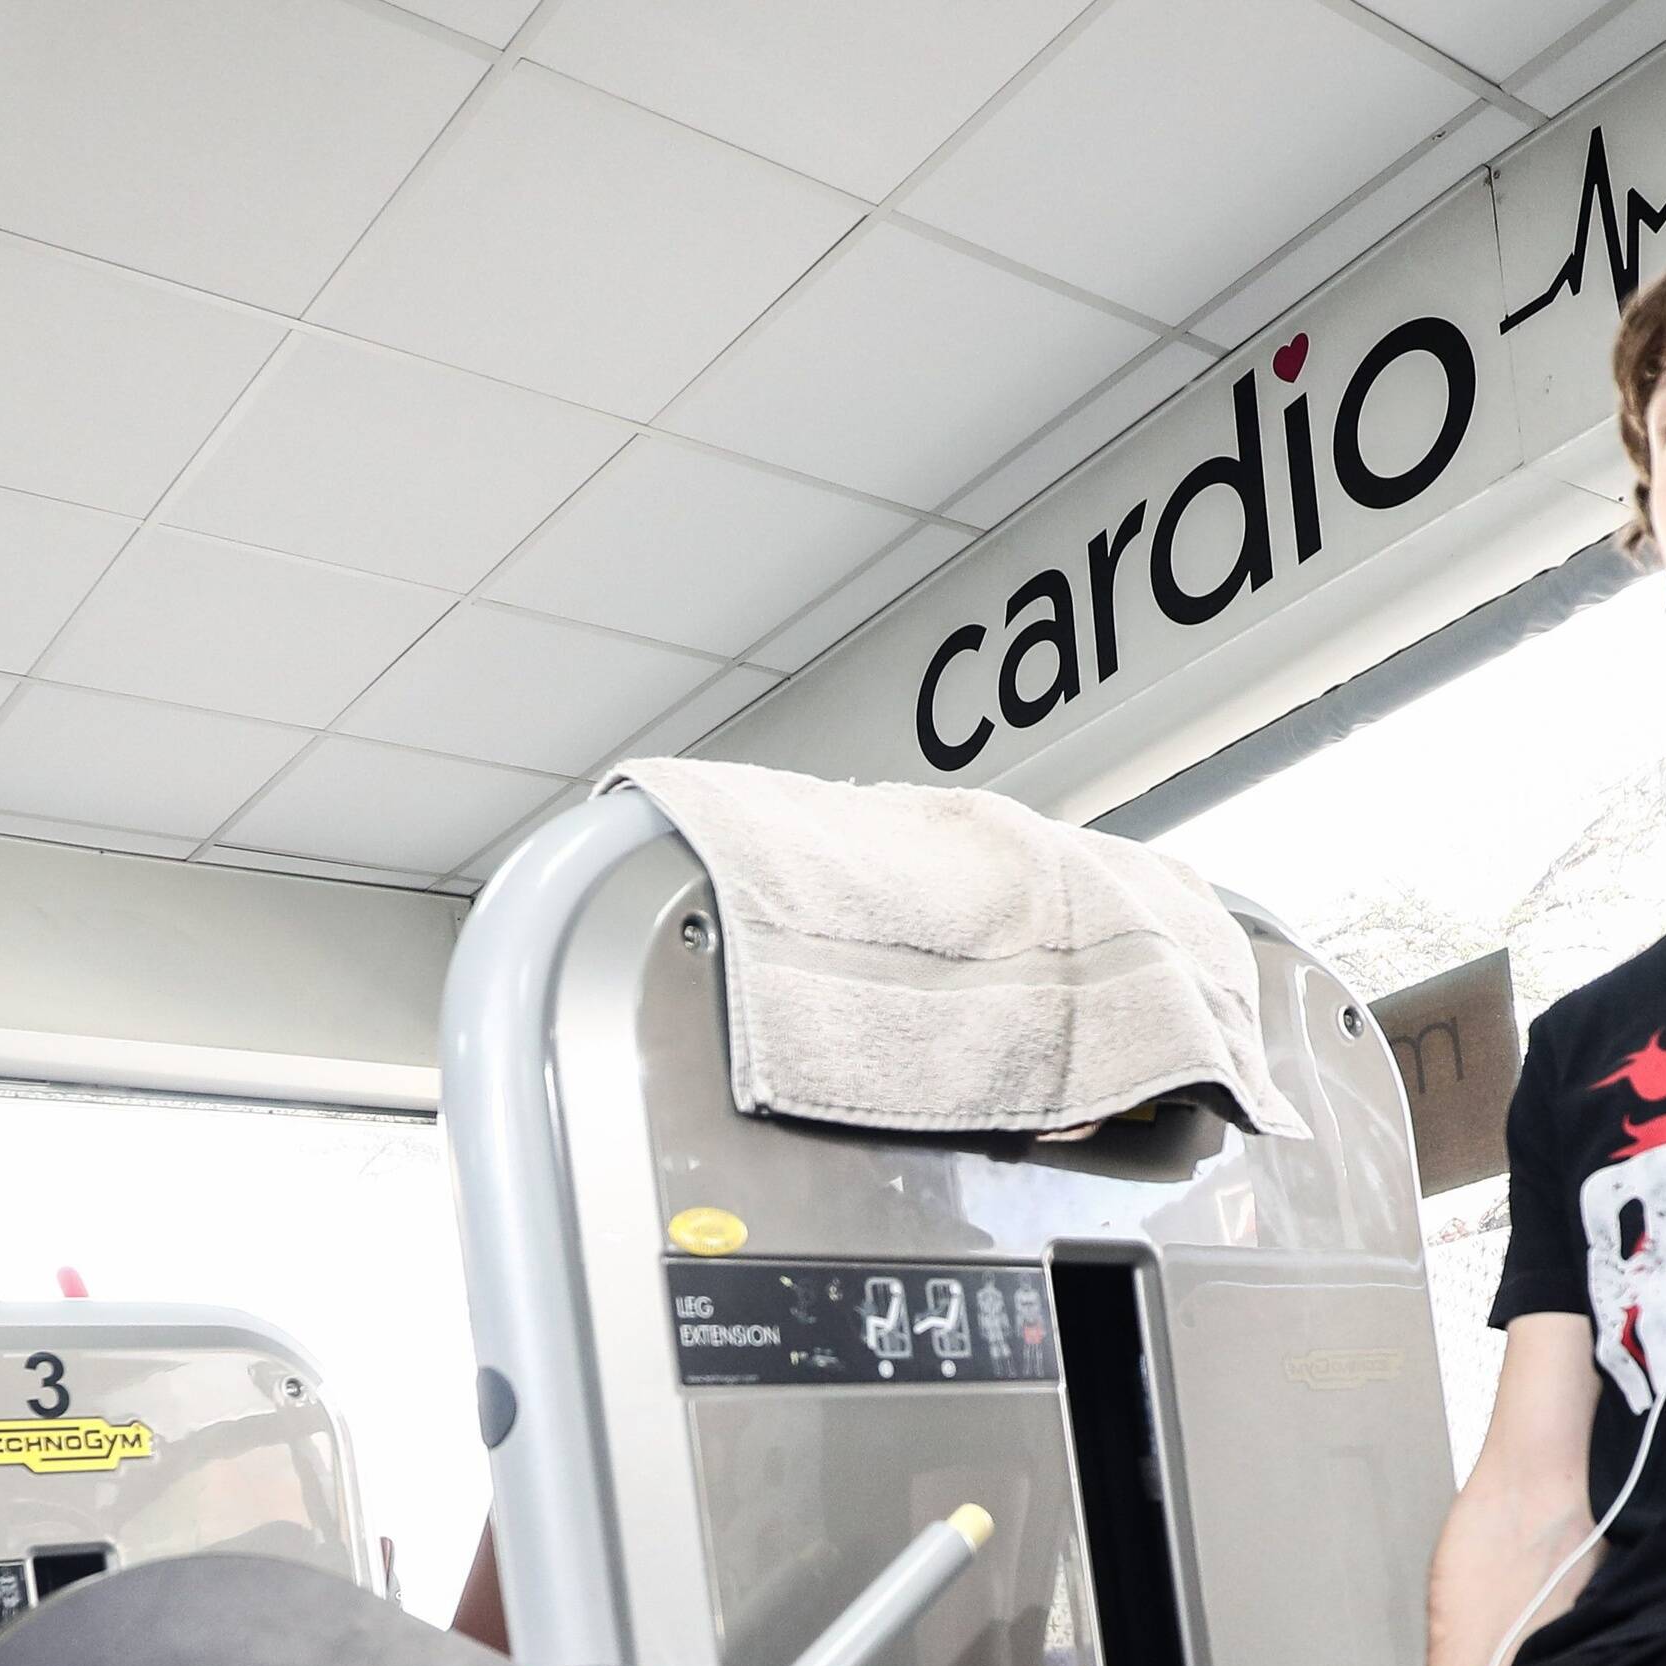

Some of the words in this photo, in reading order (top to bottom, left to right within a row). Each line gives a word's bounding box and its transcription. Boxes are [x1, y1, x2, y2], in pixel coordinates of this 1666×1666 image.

[915, 316, 1476, 772] cardio
[675, 1296, 714, 1318] LEG
[679, 1324, 781, 1347] EXTENSION
[24, 1351, 70, 1418] 3
